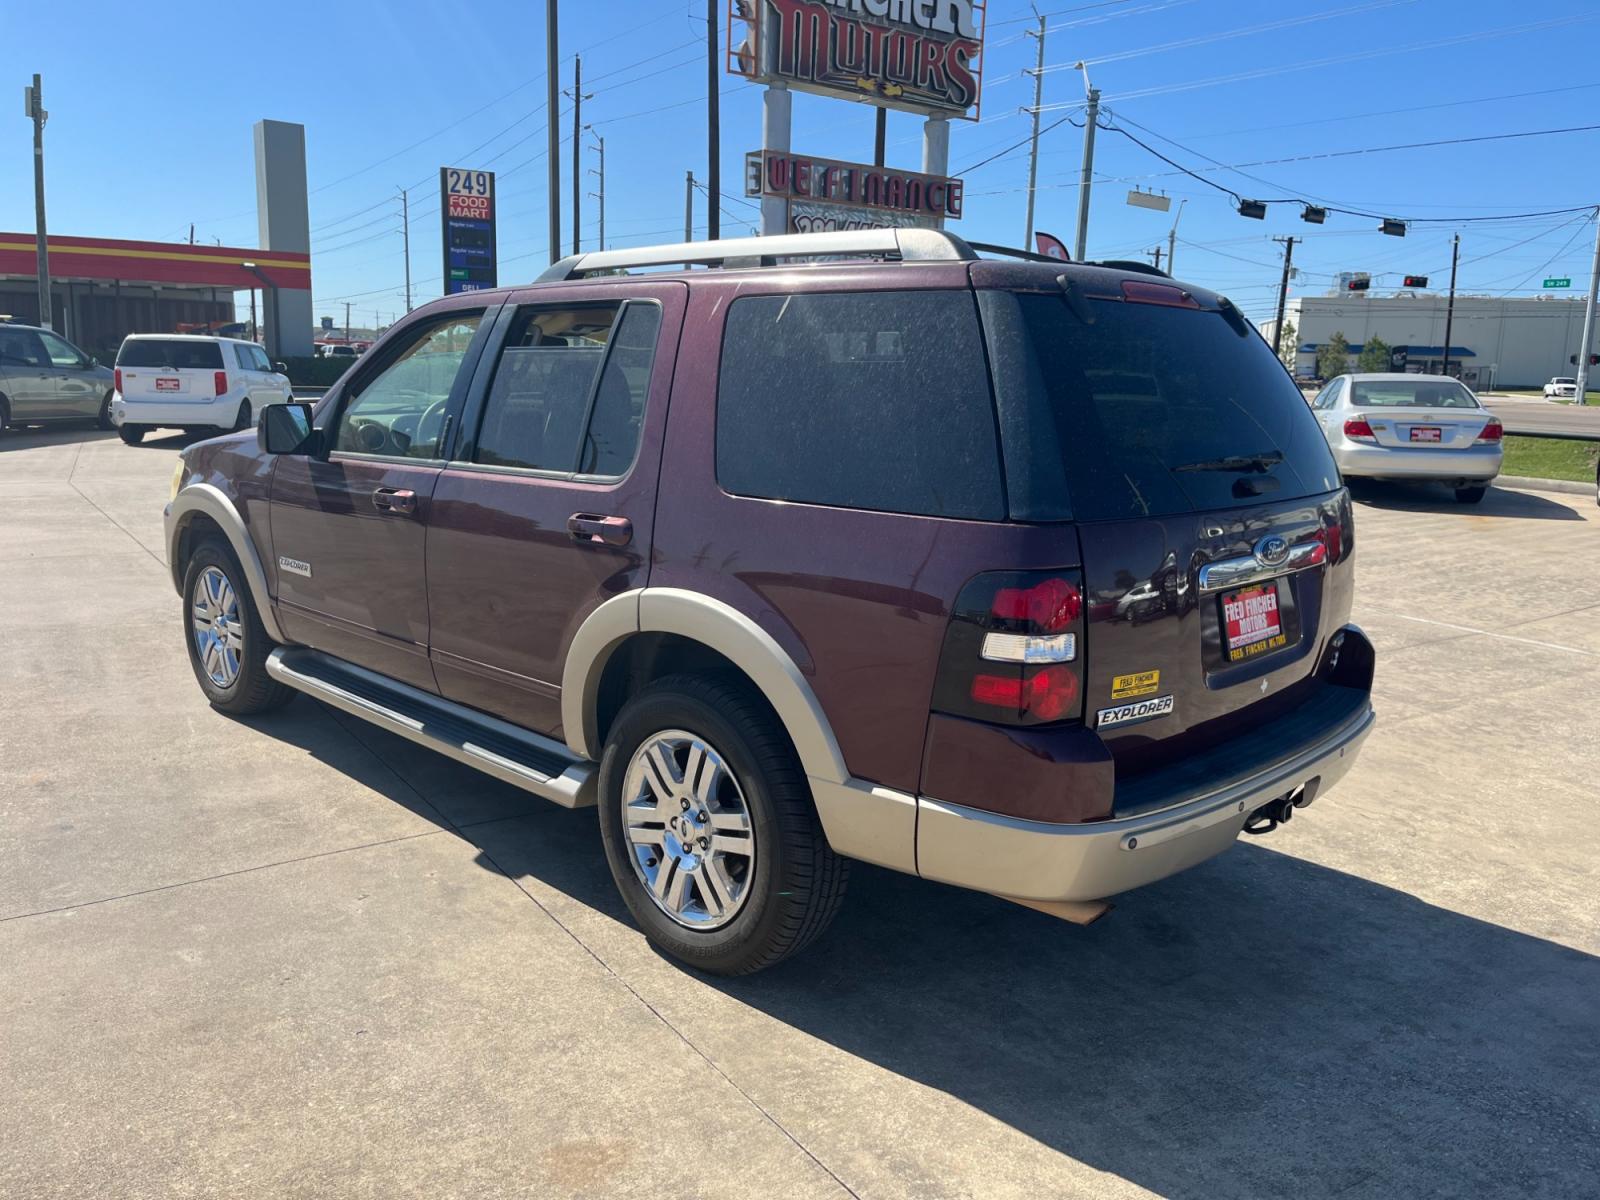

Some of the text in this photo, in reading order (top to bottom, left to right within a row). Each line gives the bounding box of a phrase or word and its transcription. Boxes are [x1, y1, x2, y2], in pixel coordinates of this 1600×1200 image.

[769, 0, 981, 105] MOTORS
[449, 171, 487, 195] 249
[768, 156, 812, 196] WE
[822, 165, 962, 214] FINANCE
[450, 195, 488, 208] FOOD
[450, 207, 489, 219] MART
[1224, 593, 1277, 623] FRED FINCHER
[1239, 613, 1268, 635] MOTORS
[1102, 698, 1172, 723] EXPLORER
